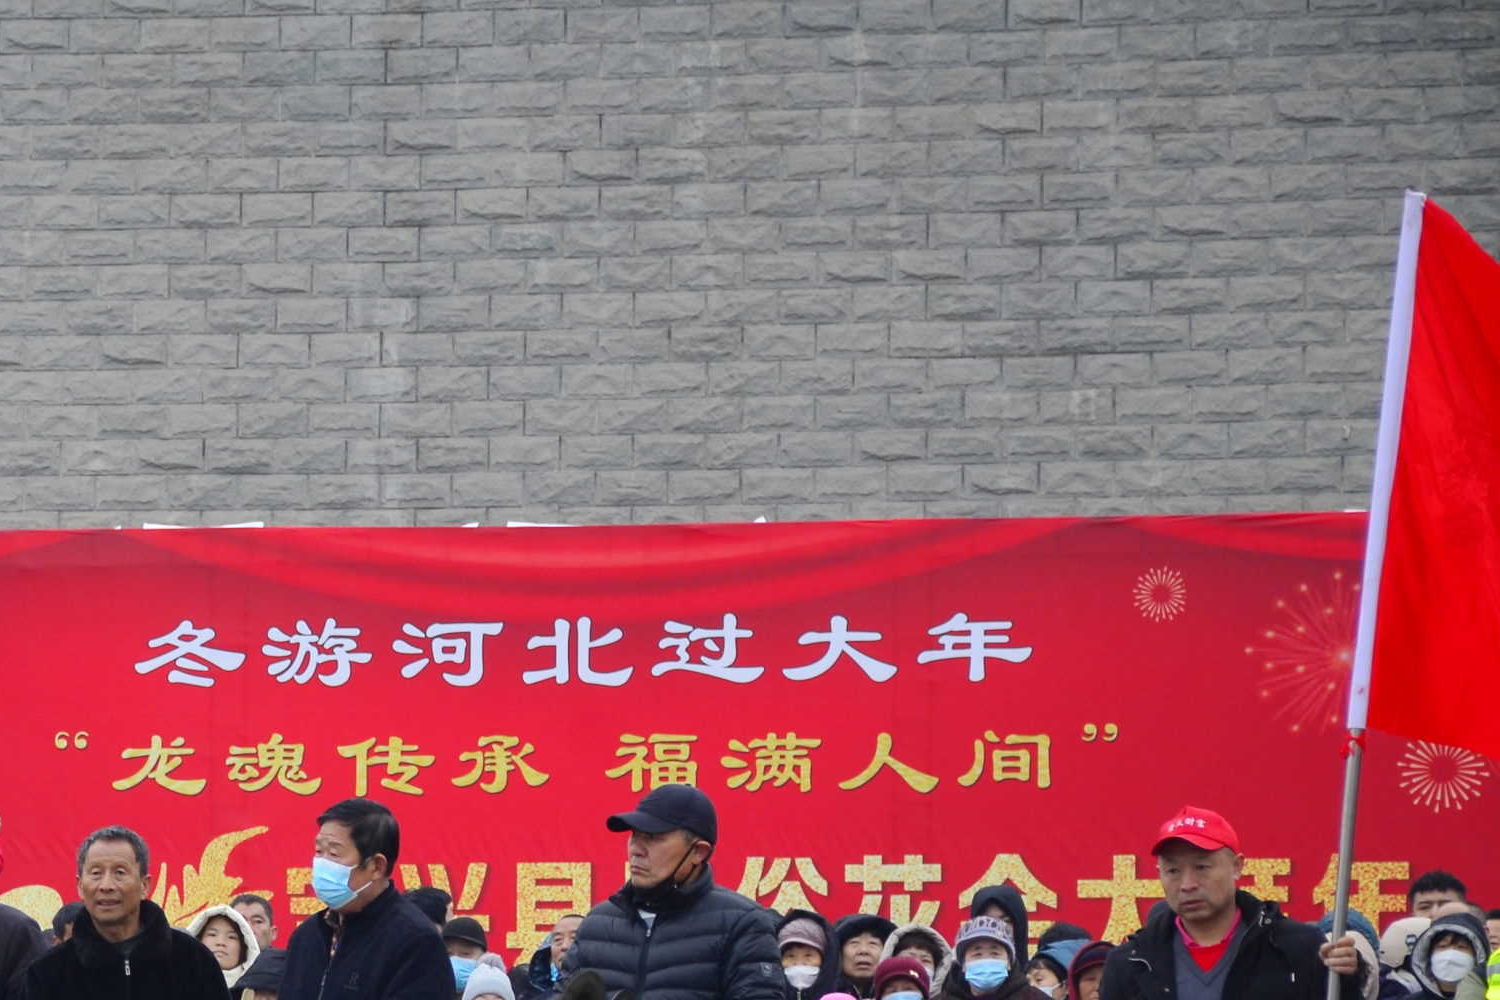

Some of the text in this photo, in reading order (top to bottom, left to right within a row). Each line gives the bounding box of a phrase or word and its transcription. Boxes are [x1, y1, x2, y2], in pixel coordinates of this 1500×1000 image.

[134, 612, 1033, 688] 冬游河北过大年
